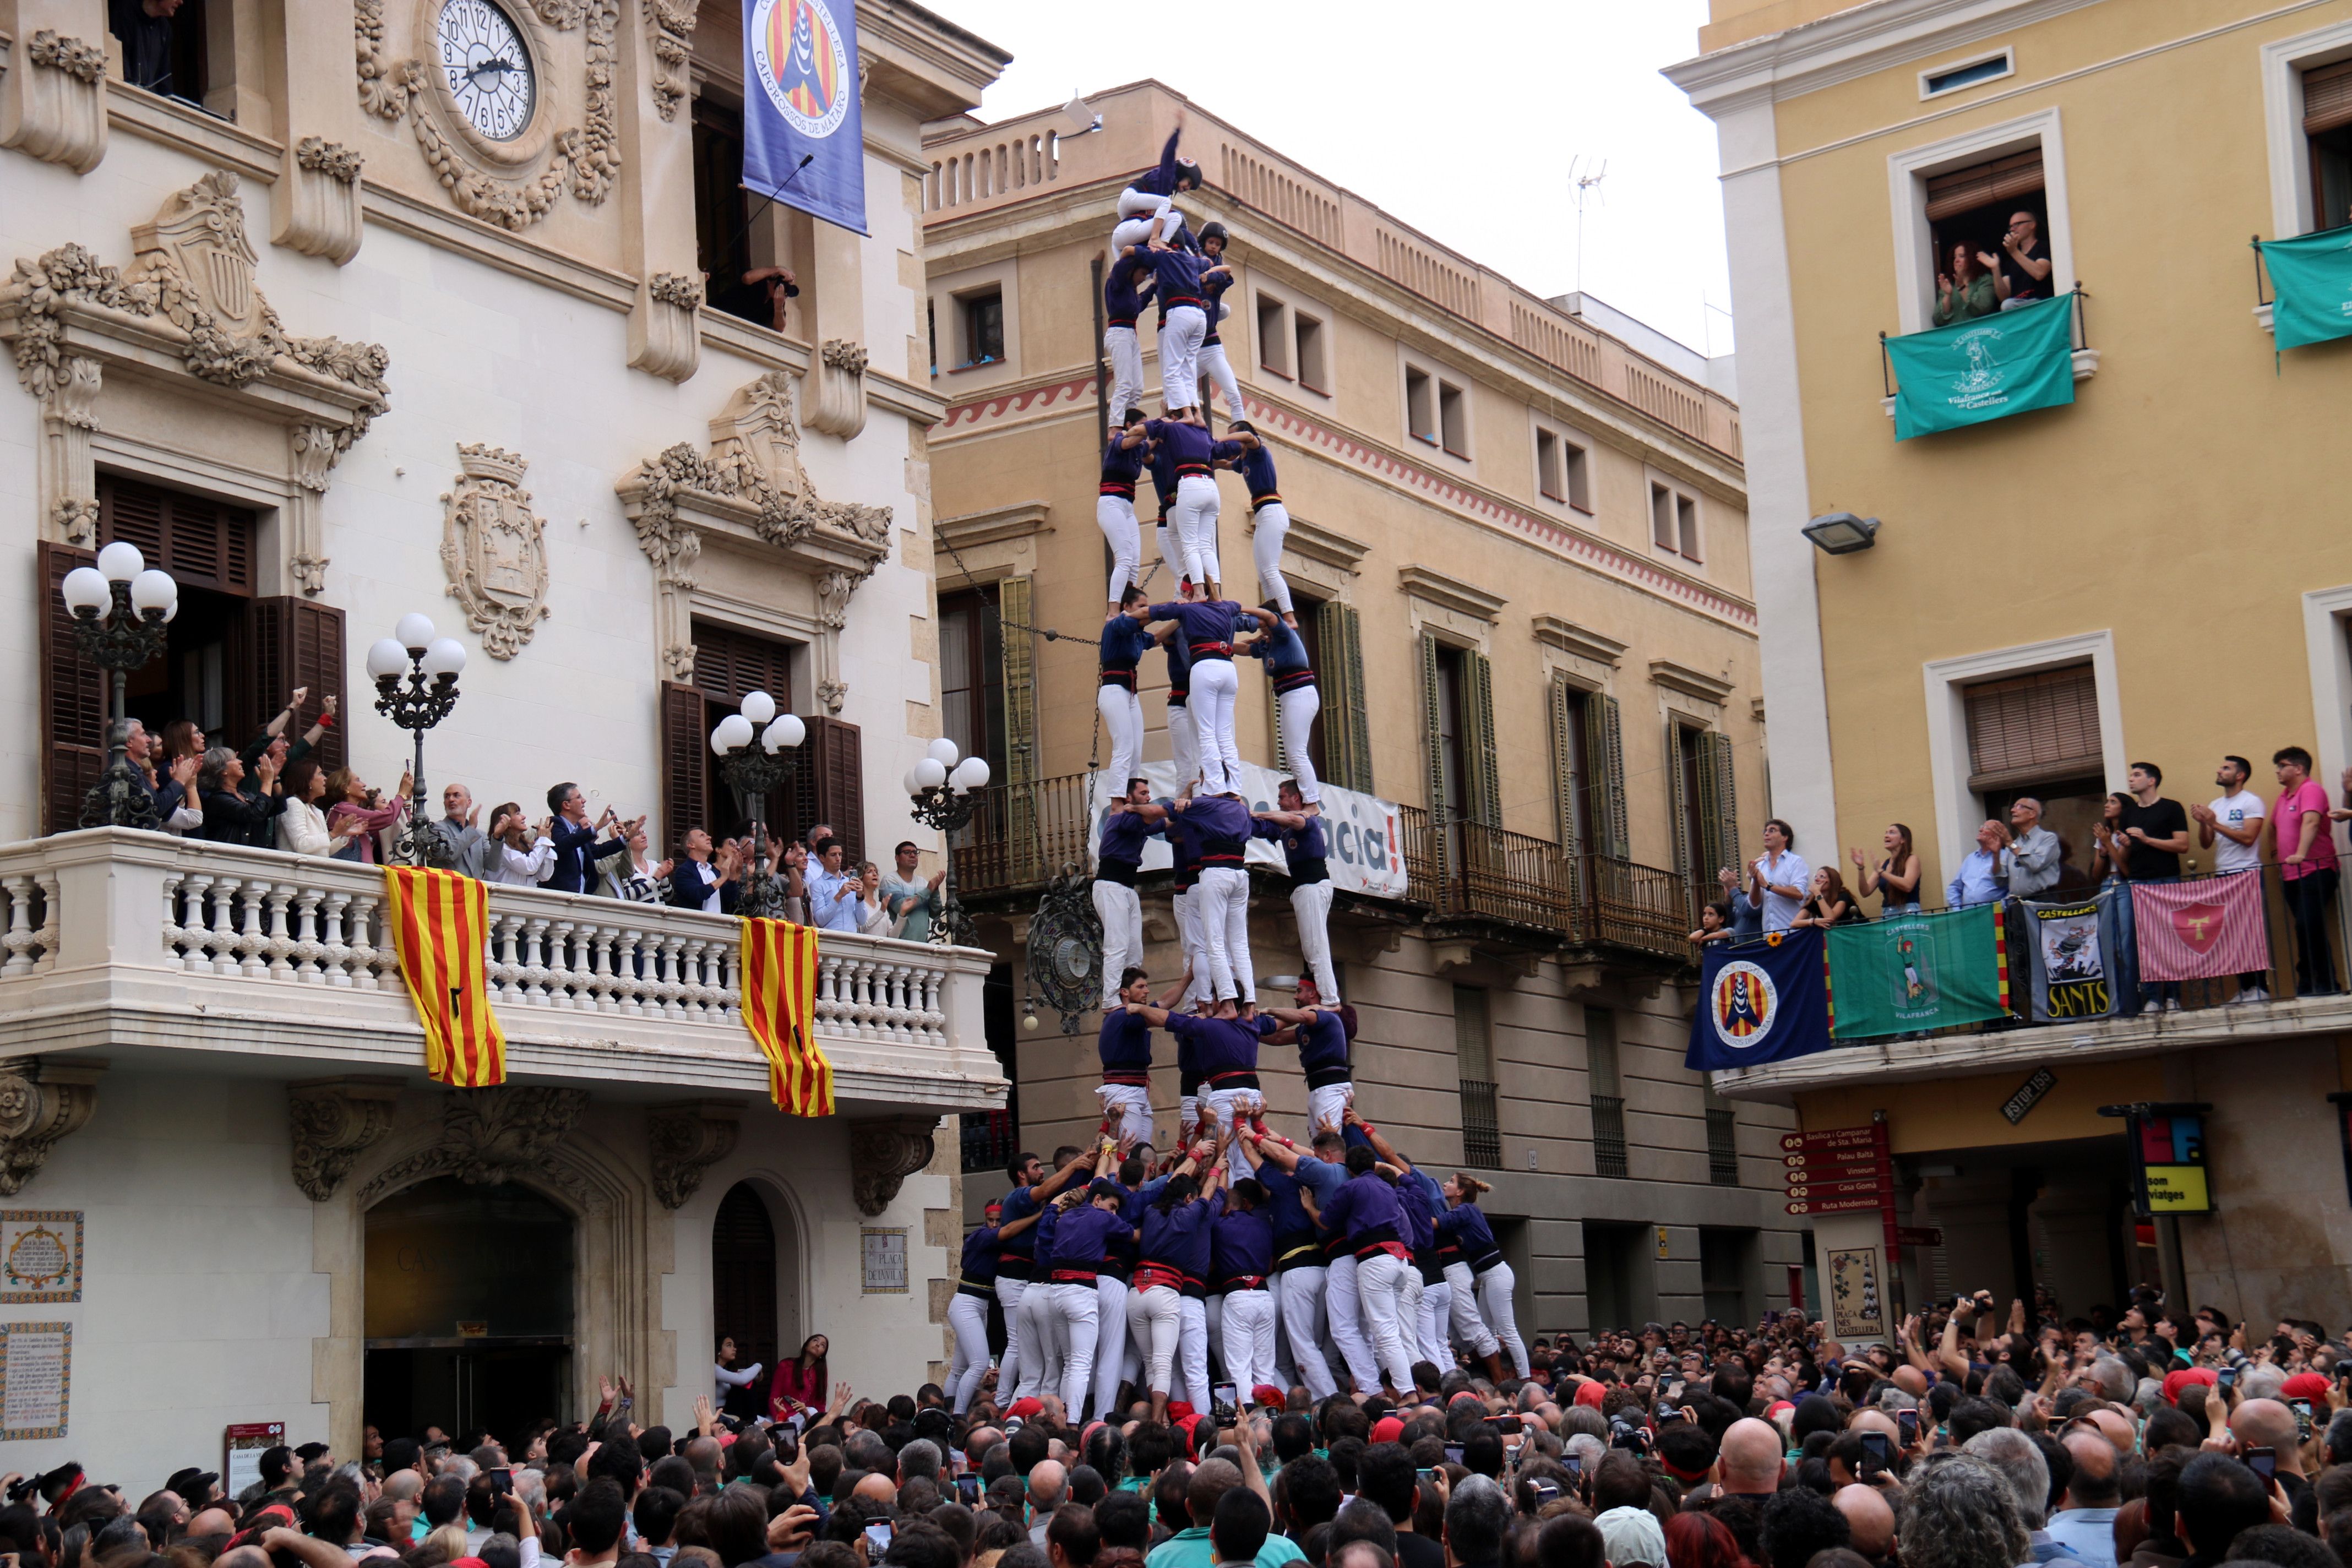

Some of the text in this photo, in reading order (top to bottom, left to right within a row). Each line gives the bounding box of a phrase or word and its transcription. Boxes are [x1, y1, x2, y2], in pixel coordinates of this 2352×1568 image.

[459, 7, 468, 28] 11
[475, 7, 487, 31] 12
[446, 19, 459, 41] 10
[496, 24, 500, 43] 1
[444, 42, 452, 63] 9
[508, 46, 515, 66] 2
[450, 70, 458, 90] 8
[513, 74, 520, 93] 3
[756, 50, 807, 130] CAPGROSSOS
[809, 122, 820, 134] DE
[465, 95, 472, 115] 7
[508, 96, 515, 116] 4
[481, 107, 488, 128] 6
[498, 109, 505, 129] 5
[1948, 392, 1990, 404] Vilafranca
[1966, 396, 2008, 409] Castellers
[2037, 904, 2098, 919] CASTELLERS
[1886, 924, 1930, 936] CASTELLERS
[2048, 981, 2109, 1017] SANTS
[1895, 1006, 1940, 1019] VILAFRANCA
[2003, 1085, 2033, 1119] #STOP
[2030, 1070, 2050, 1090] 155
[1836, 1129, 1871, 1137] Campanar
[1856, 1151, 1874, 1159] Baltà
[1847, 1167, 1876, 1175] Vinseum
[2147, 1177, 2168, 1185] som
[1839, 1199, 1878, 1208] Modernista
[2148, 1189, 2185, 1202] viatges
[868, 1270, 903, 1280] DE LA VILA
[1838, 1326, 1879, 1335] CASTELLERA
